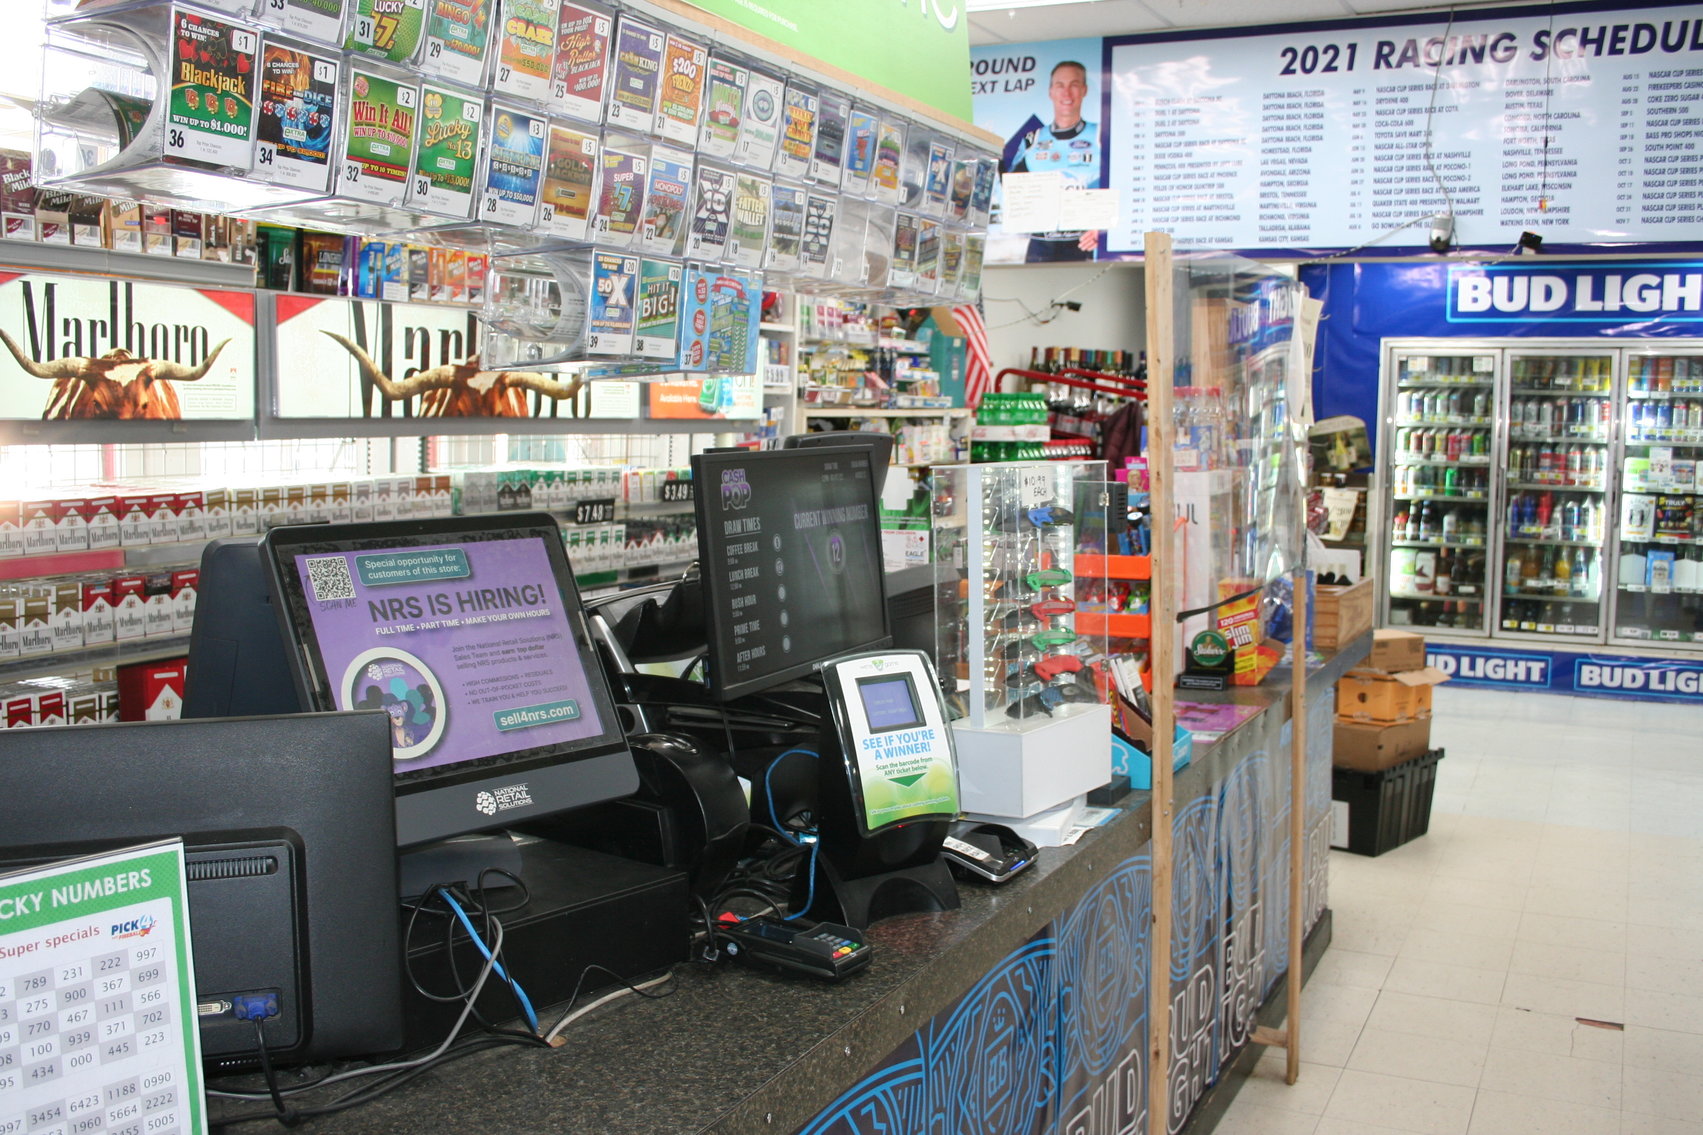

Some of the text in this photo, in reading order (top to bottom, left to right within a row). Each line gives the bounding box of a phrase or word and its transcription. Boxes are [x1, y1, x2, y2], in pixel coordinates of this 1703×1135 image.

[374, 0, 403, 13] LUCKY
[435, 1, 470, 25] BINGO
[181, 29, 207, 42] TO WIN!
[188, 23, 220, 38] CHANCES
[359, 20, 371, 38] 31
[506, 17, 554, 46] CRAZE
[238, 36, 249, 50] $1
[561, 33, 592, 50] High
[430, 42, 441, 58] 29
[568, 49, 597, 67] Roller
[1279, 42, 1357, 75] 2021
[1373, 32, 1519, 70] RACING
[318, 66, 328, 79] $1
[500, 67, 510, 83] 27
[673, 58, 696, 78] $200
[1648, 70, 1671, 78] NASCAR
[181, 61, 246, 95] Blackjack
[1004, 78, 1035, 92] LAP
[263, 80, 333, 108] FIRE DICE
[555, 84, 564, 98] 25
[1648, 83, 1682, 91] FIREKEEPERS
[401, 91, 411, 105] $2
[1647, 95, 1662, 103] COKE
[1680, 93, 1699, 102] SUGAR
[353, 101, 413, 135] Win It All!
[611, 103, 620, 117] 23
[1646, 107, 1677, 115] SOUTHERN
[172, 114, 248, 137] WIN UP $1,000!
[1375, 120, 1403, 128] COCA-COLA
[169, 129, 185, 148] 36
[354, 127, 367, 138] WIN
[425, 120, 471, 147] Lucky
[1645, 131, 1659, 139] BASS
[455, 140, 473, 160] 13
[1645, 143, 1683, 152] SOUTH POINT
[259, 147, 273, 165] 34
[557, 158, 586, 171] GOLD
[2, 169, 30, 185] Black
[346, 165, 359, 182] 32
[614, 172, 634, 183] SUPER
[11, 179, 33, 193] Mild
[417, 180, 428, 195] 30
[655, 181, 684, 194] MONOPOLY
[487, 198, 496, 212] 28
[738, 197, 764, 213] FATTER
[543, 207, 552, 221] 26
[600, 219, 608, 232] 24
[647, 283, 660, 294] HIT
[1457, 273, 1703, 313] BUD LIGH
[642, 286, 675, 318] BIG!
[19, 280, 209, 366] Marlboro
[590, 336, 598, 348] 39
[636, 339, 644, 351] 38
[685, 354, 692, 365] 37
[722, 469, 746, 483] CASH
[664, 482, 688, 500] $3.49
[721, 482, 751, 511] POP
[577, 502, 603, 521] $7.48
[794, 510, 820, 529] CURRENT
[724, 517, 760, 535] DRAW TIMES
[727, 542, 758, 556] COFFEE BREAK
[365, 554, 456, 570] Special opportunity for
[368, 569, 411, 579] customers
[422, 566, 437, 574] this
[439, 565, 461, 573] store:
[729, 567, 759, 582] LUNCH BREAK
[320, 599, 357, 612] SCAN ME
[367, 584, 546, 623] NRS IS HIRING!
[54, 620, 82, 636] Marlboro
[376, 608, 550, 636] FULL TIME PART TIME MAKE YOUR OWN HOURS
[1221, 617, 1233, 627] 120
[22, 629, 51, 645] Marlboro
[1225, 625, 1250, 640] slim
[1232, 634, 1253, 650] jim
[737, 645, 766, 663] AFTER HOURS
[1460, 657, 1546, 682] LIGHT
[1580, 665, 1645, 689] BUD
[500, 705, 574, 726] sell4nrs.com
[863, 729, 935, 750] SEE IF YOU'RE
[875, 741, 931, 760] A WINNER!
[899, 758, 919, 766] barcode
[896, 767, 910, 775] ticket
[494, 785, 528, 796] NATIONAL
[496, 791, 530, 804] RETAIL
[499, 798, 532, 810] SOLUTIONS
[52, 868, 152, 908] NUMBERS
[45, 925, 100, 948] specials
[24, 947, 157, 991] 789 231 222 997
[26, 968, 159, 1014] 275 900 367 699
[28, 990, 161, 1036] 770 467 111 566
[30, 1021, 126, 1057] 100 939 371
